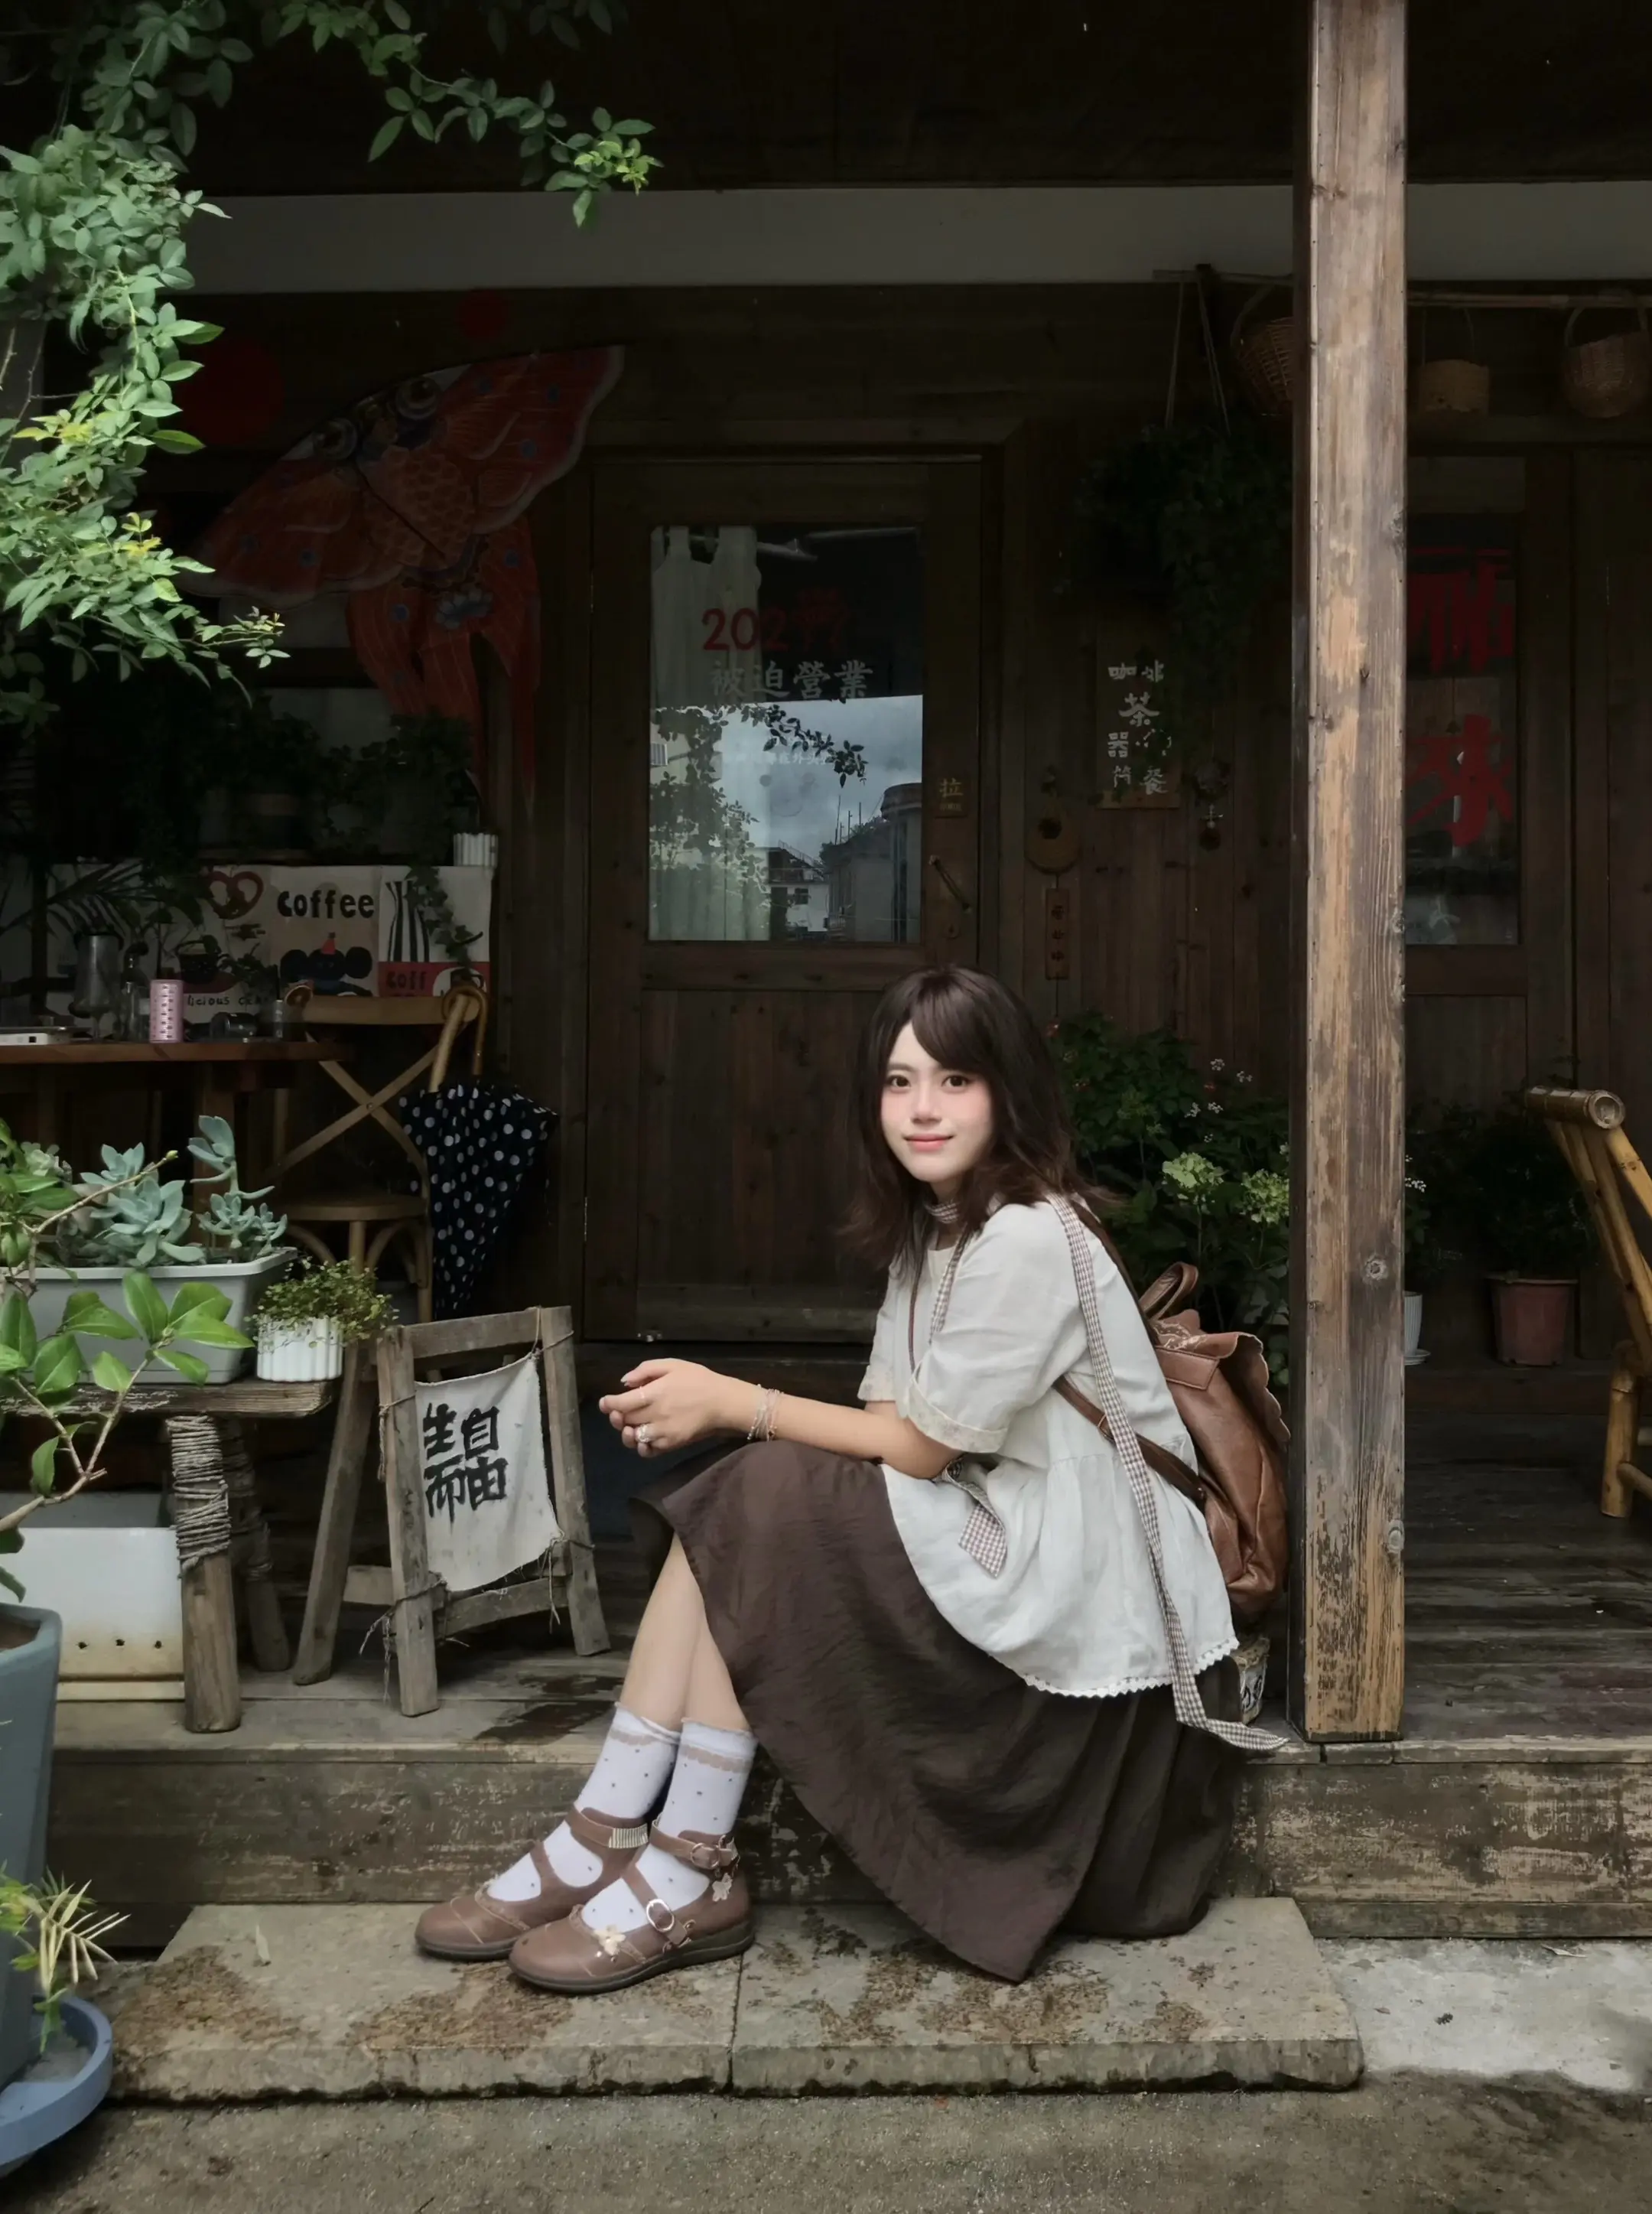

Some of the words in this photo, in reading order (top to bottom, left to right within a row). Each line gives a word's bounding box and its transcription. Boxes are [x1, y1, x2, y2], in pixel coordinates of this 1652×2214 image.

[711, 659, 874, 699] 被迫營業
[1118, 692, 1160, 727] 茶
[939, 777, 964, 798] 拉
[461, 1406, 509, 1510] 自由
